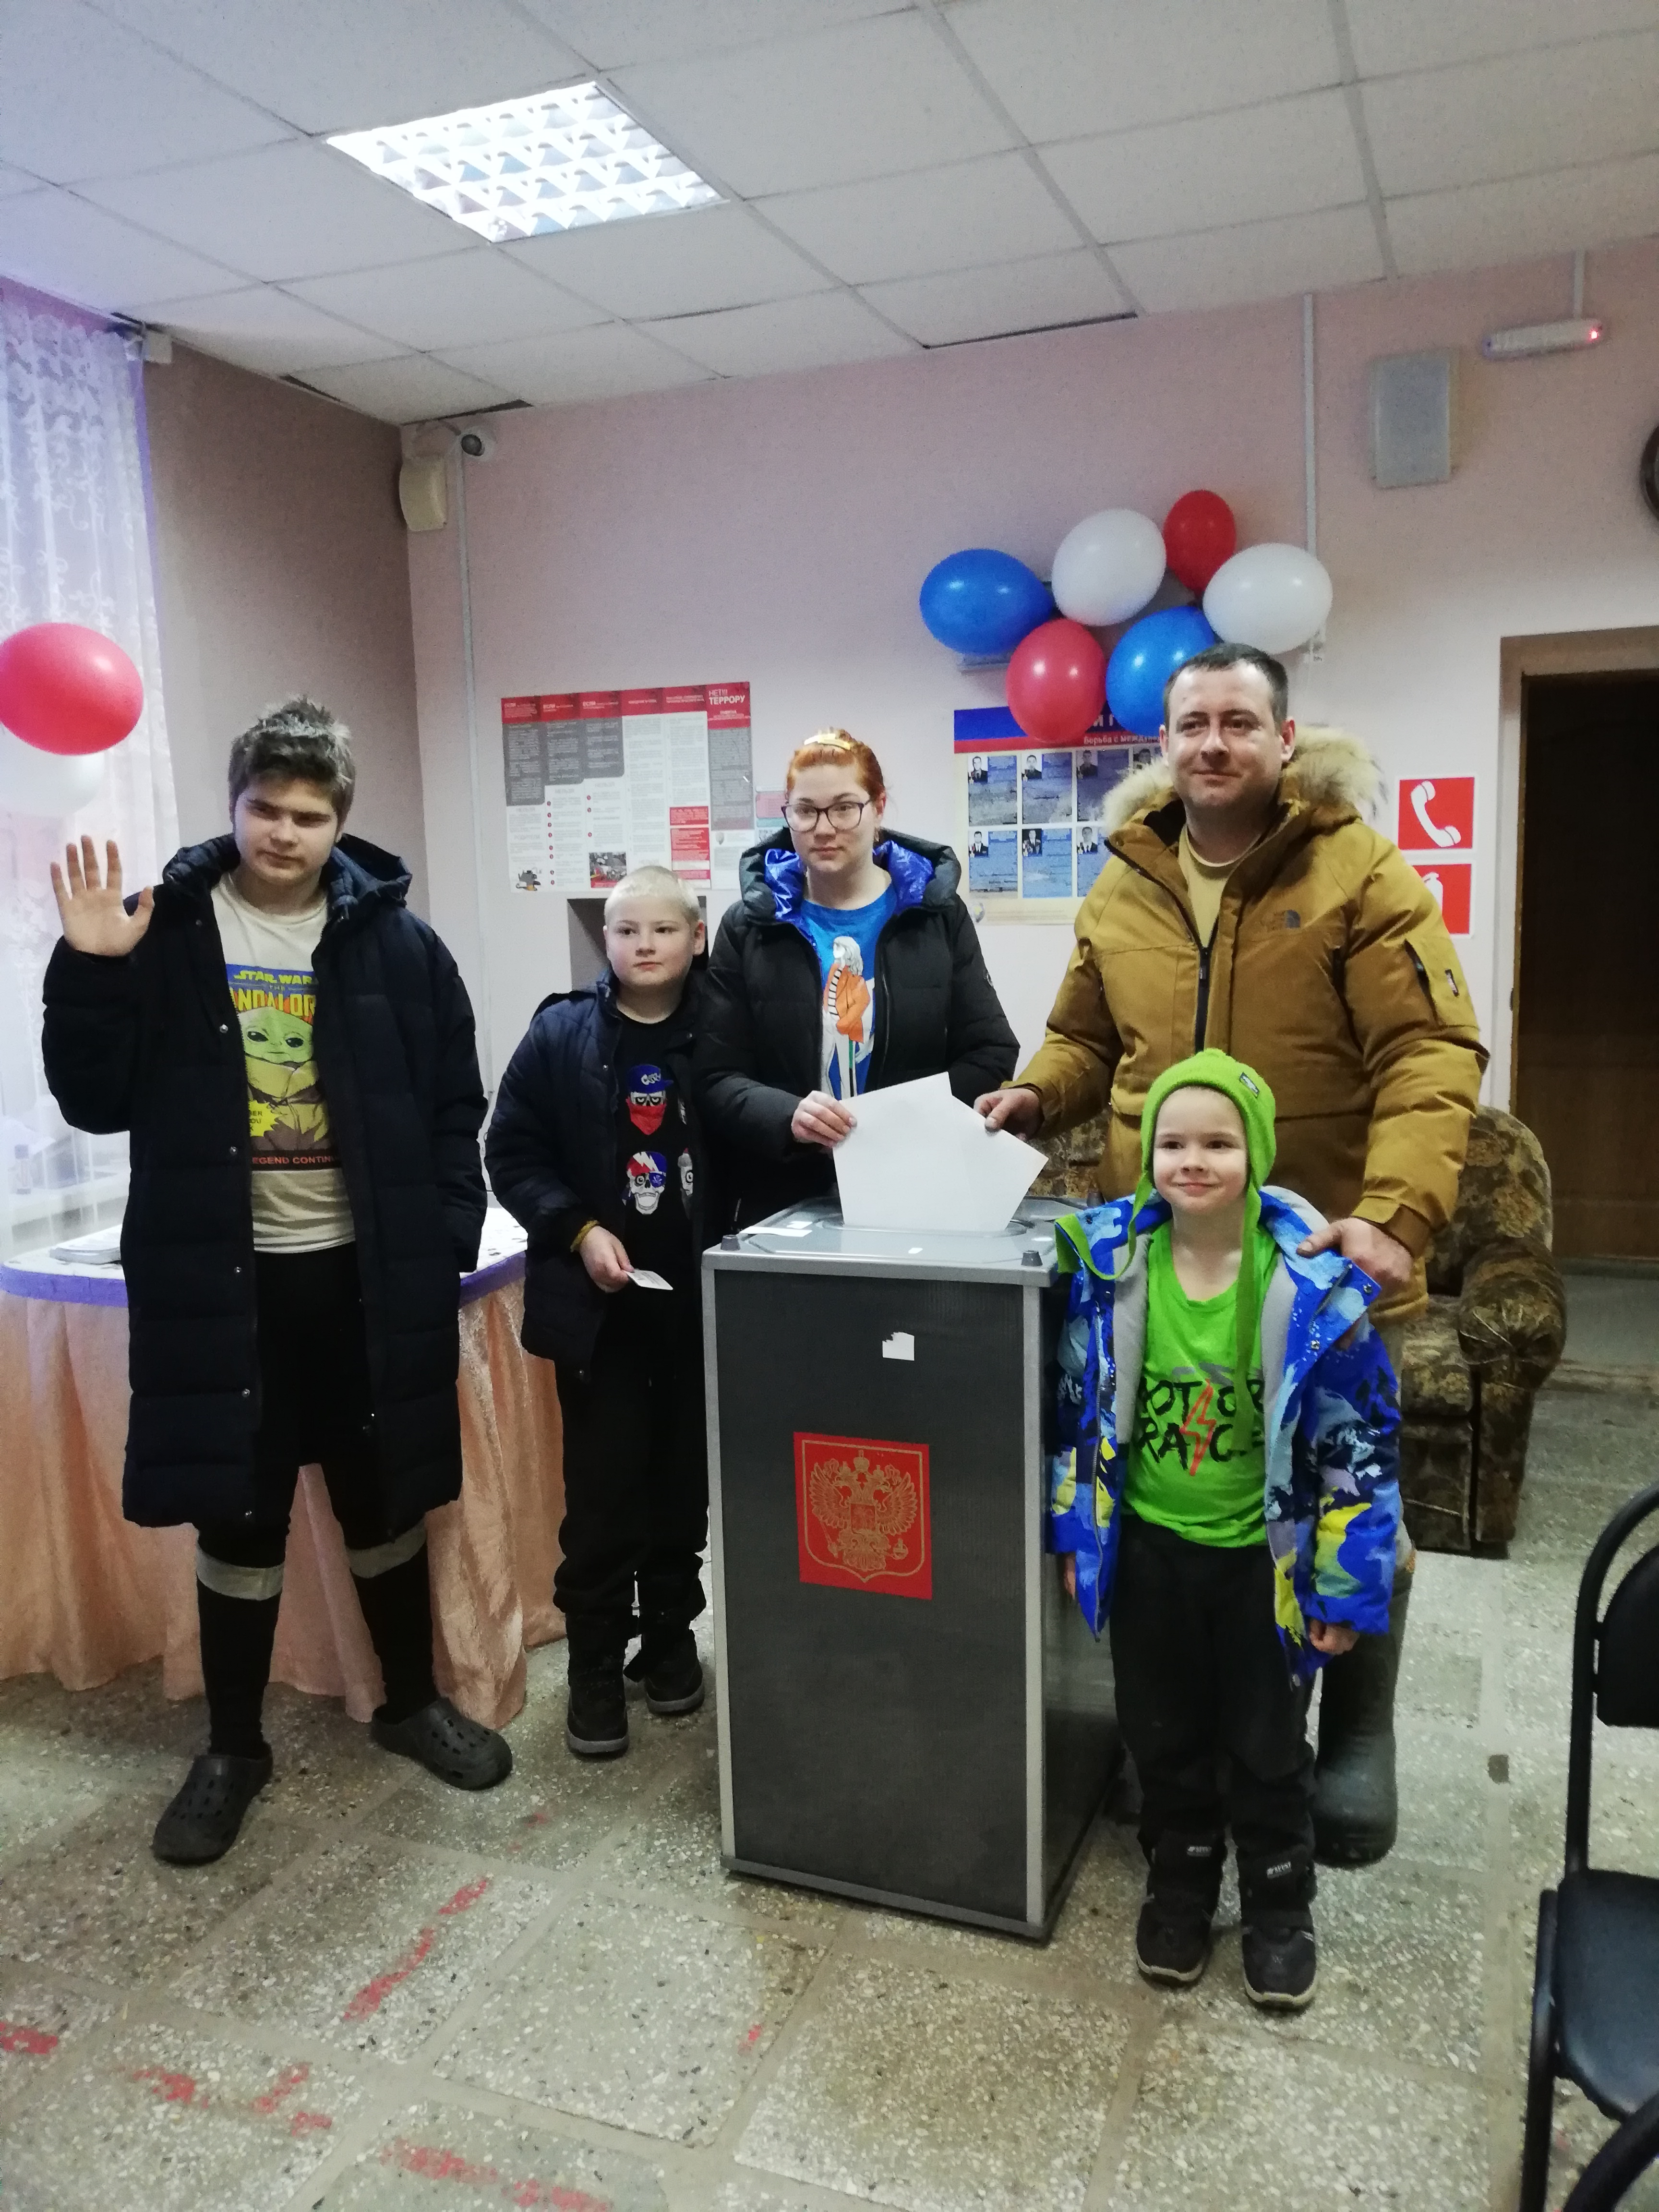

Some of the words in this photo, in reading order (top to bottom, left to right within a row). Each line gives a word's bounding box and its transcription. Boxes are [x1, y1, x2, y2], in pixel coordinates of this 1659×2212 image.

[709, 695, 745, 705] ТЕРРОРУ
[234, 970, 277, 984] STAR
[278, 974, 313, 985] WAR
[292, 1156, 332, 1164] CONTIN
